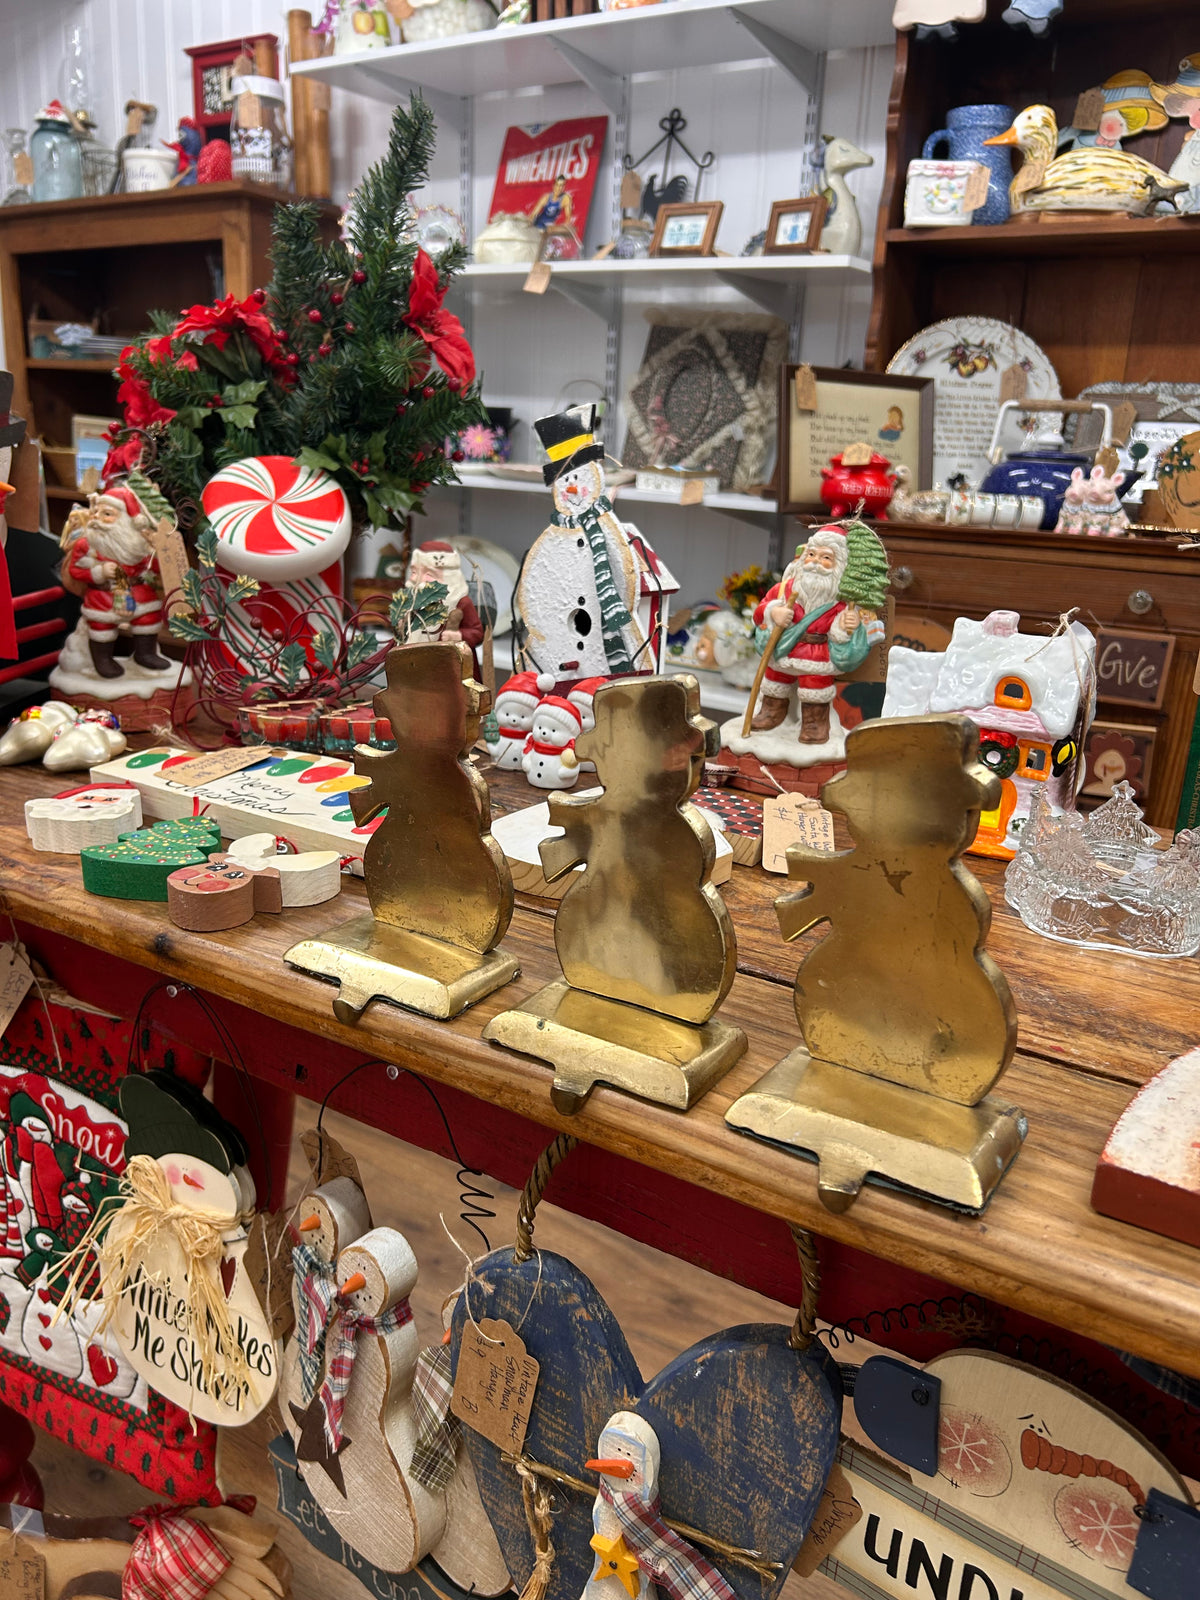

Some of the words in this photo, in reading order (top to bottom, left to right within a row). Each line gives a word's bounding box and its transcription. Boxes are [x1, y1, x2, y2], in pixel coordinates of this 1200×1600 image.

[504, 133, 595, 185] WHEATIES
[229, 771, 296, 801] Merry
[808, 816, 820, 840] Santa
[41, 1092, 124, 1167] Snow
[131, 1311, 165, 1368] Me
[461, 1395, 479, 1414] B
[479, 1361, 502, 1408] Hanger
[499, 1355, 521, 1412] Snowman
[514, 1359, 536, 1405] Vintage
[510, 1410, 528, 1445] Heart
[278, 1467, 327, 1536] Let
